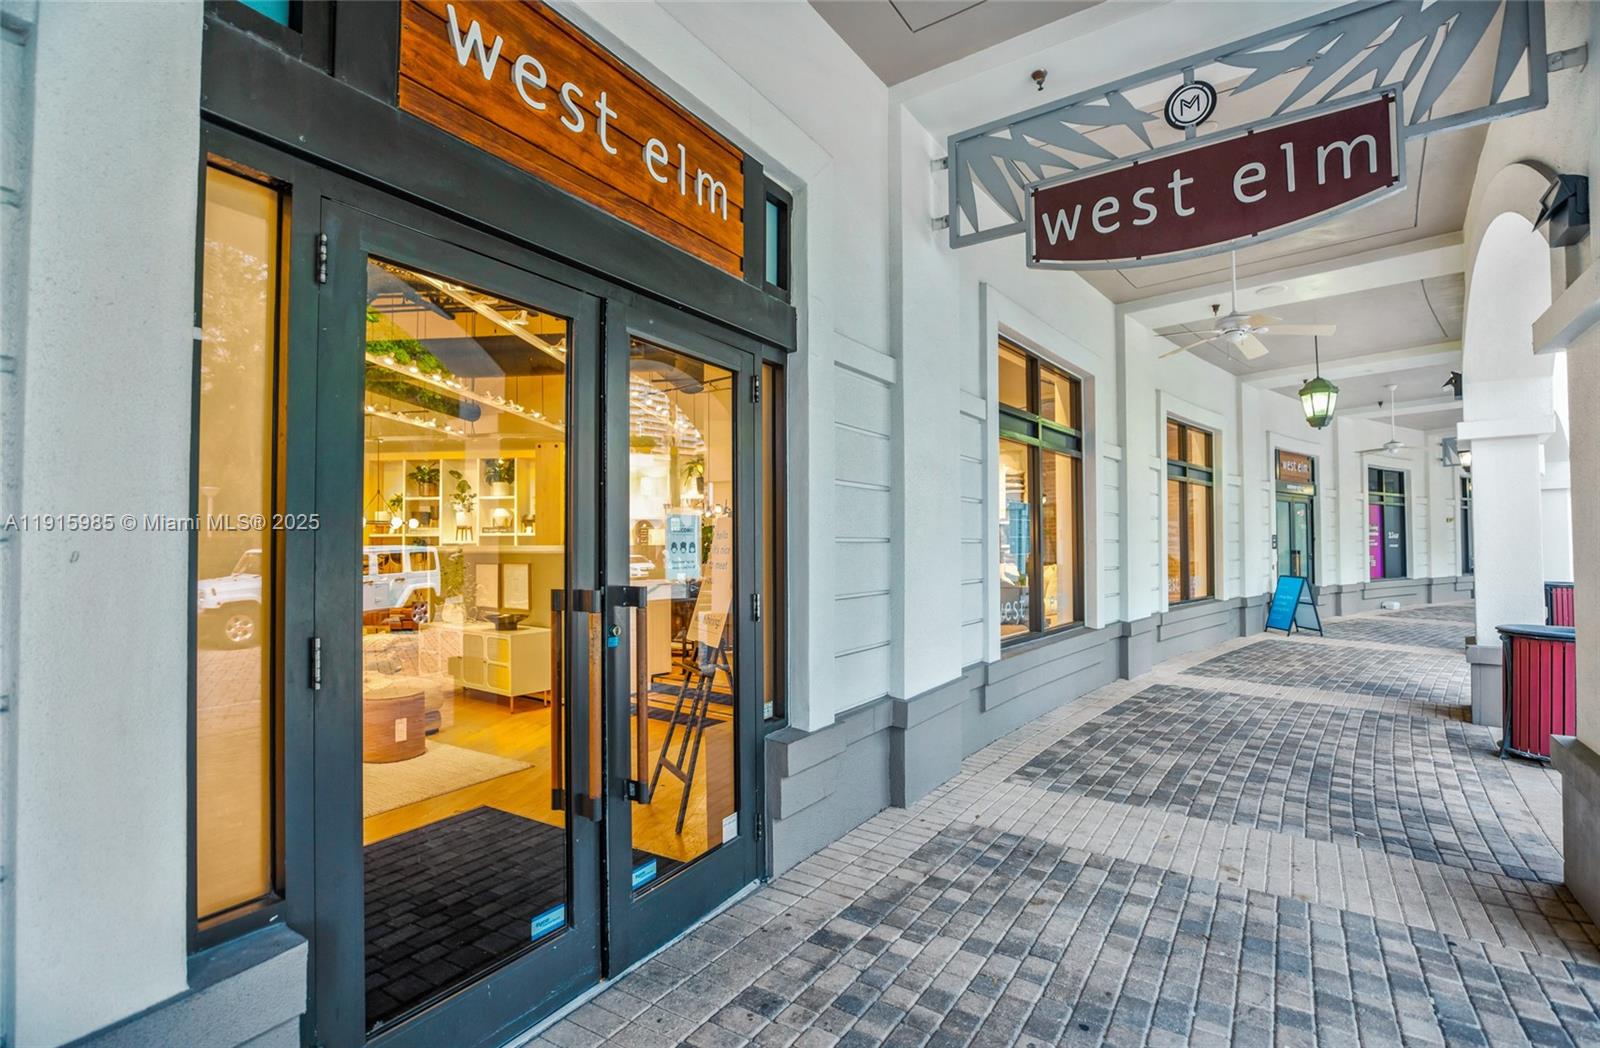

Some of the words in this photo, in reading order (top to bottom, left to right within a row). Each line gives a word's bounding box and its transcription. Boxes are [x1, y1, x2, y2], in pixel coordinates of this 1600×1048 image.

[446, 4, 618, 155] west
[643, 137, 728, 221] elm
[1041, 168, 1196, 246] west
[1232, 132, 1378, 204] elm
